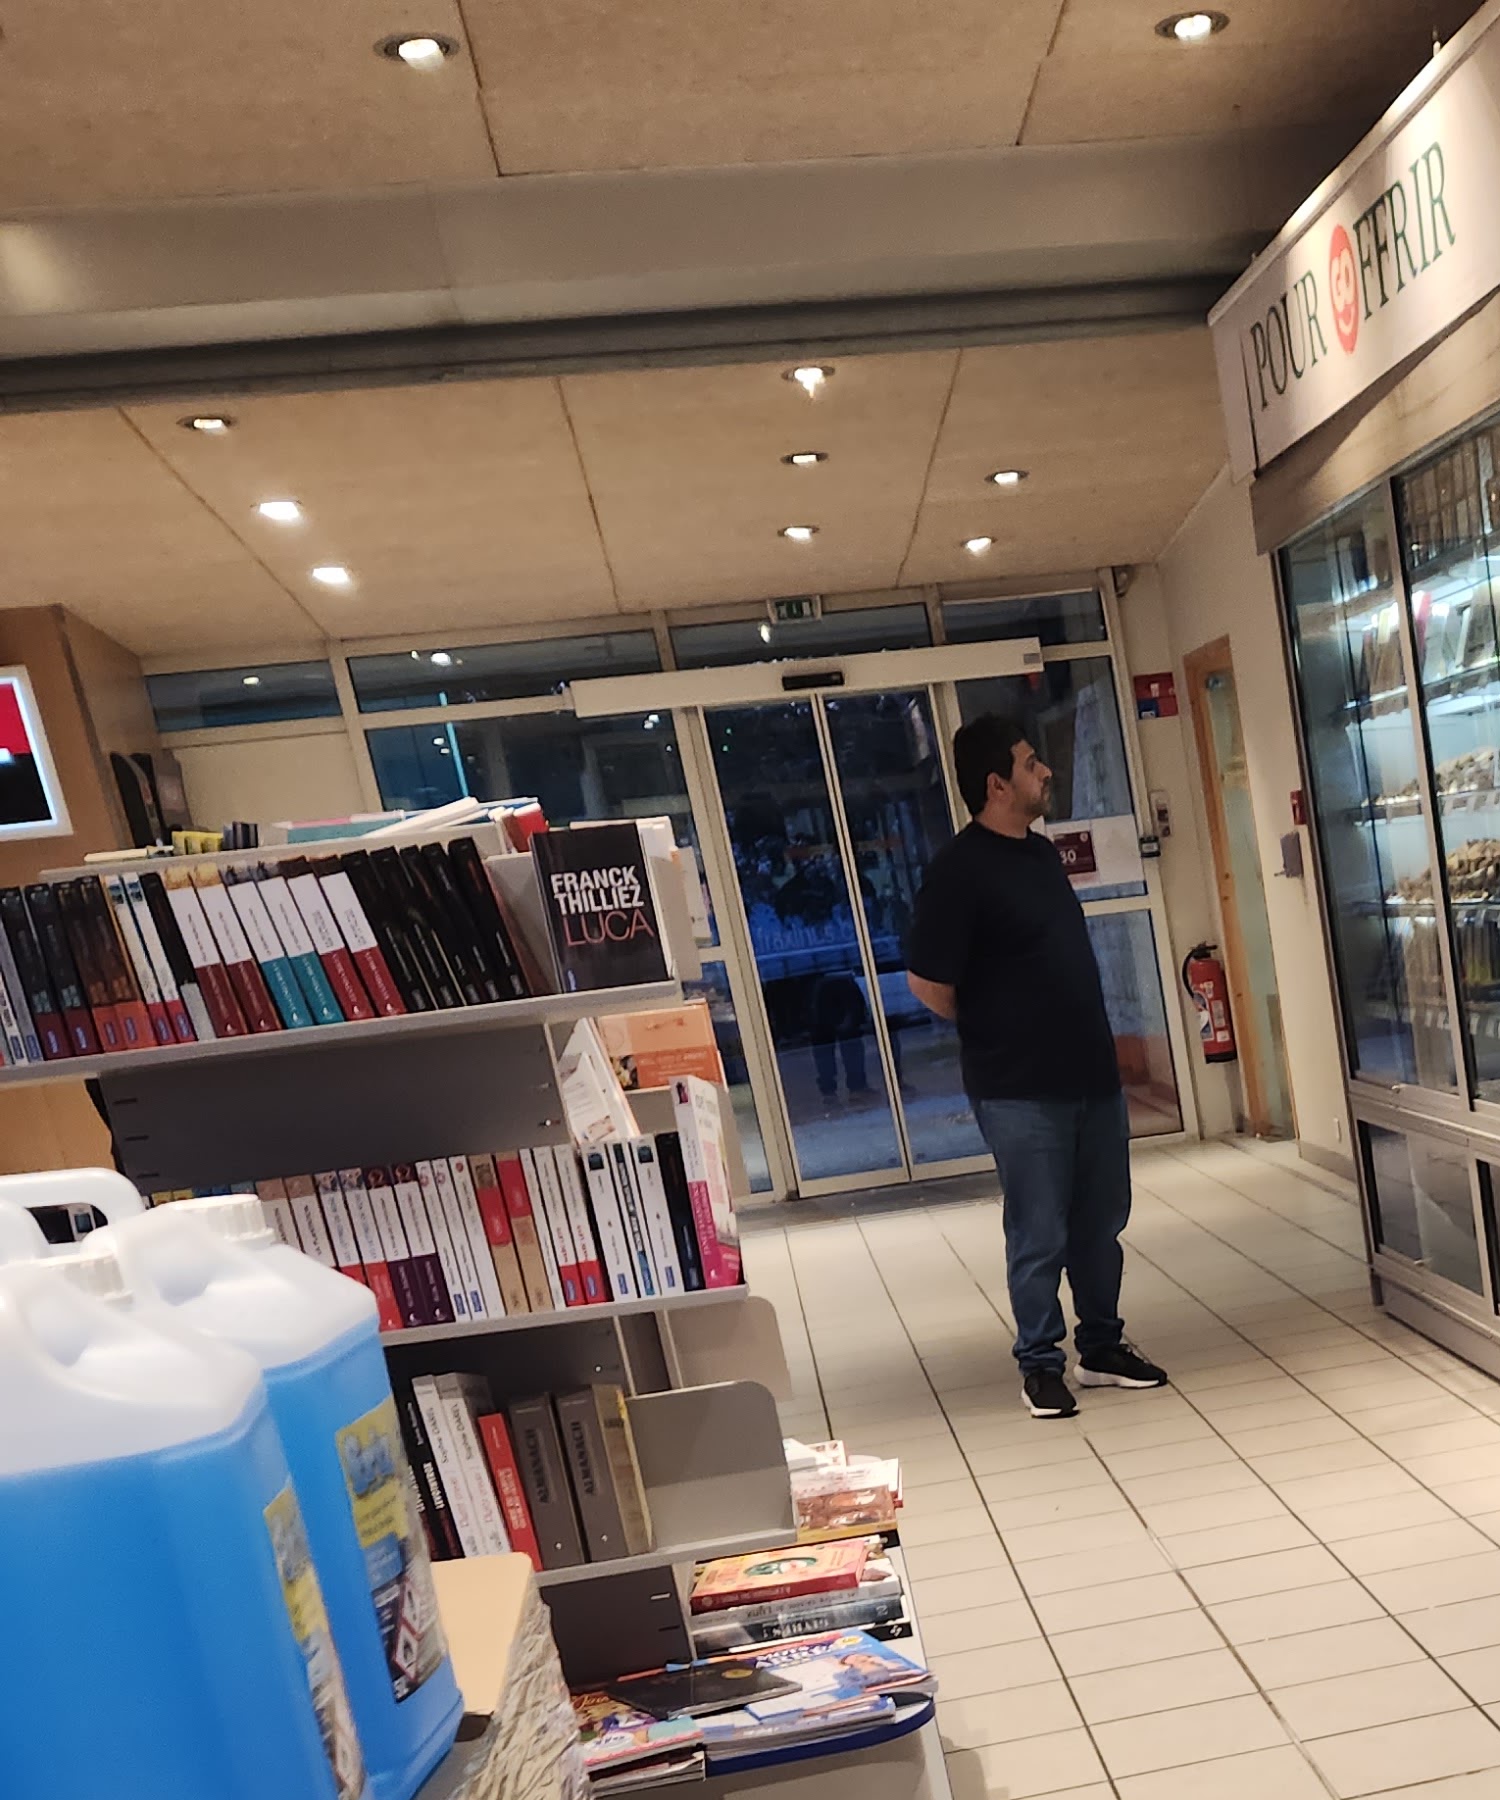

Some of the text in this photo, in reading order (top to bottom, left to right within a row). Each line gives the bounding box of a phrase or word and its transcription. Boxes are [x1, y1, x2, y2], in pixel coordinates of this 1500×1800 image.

[1250, 269, 1328, 409] POUR
[550, 865, 638, 895] FRANCK
[554, 884, 644, 915] THILLIEZ
[563, 908, 655, 947] LUCA
[524, 1428, 549, 1505] ALMANACH
[570, 1419, 595, 1495] ALMANACH
